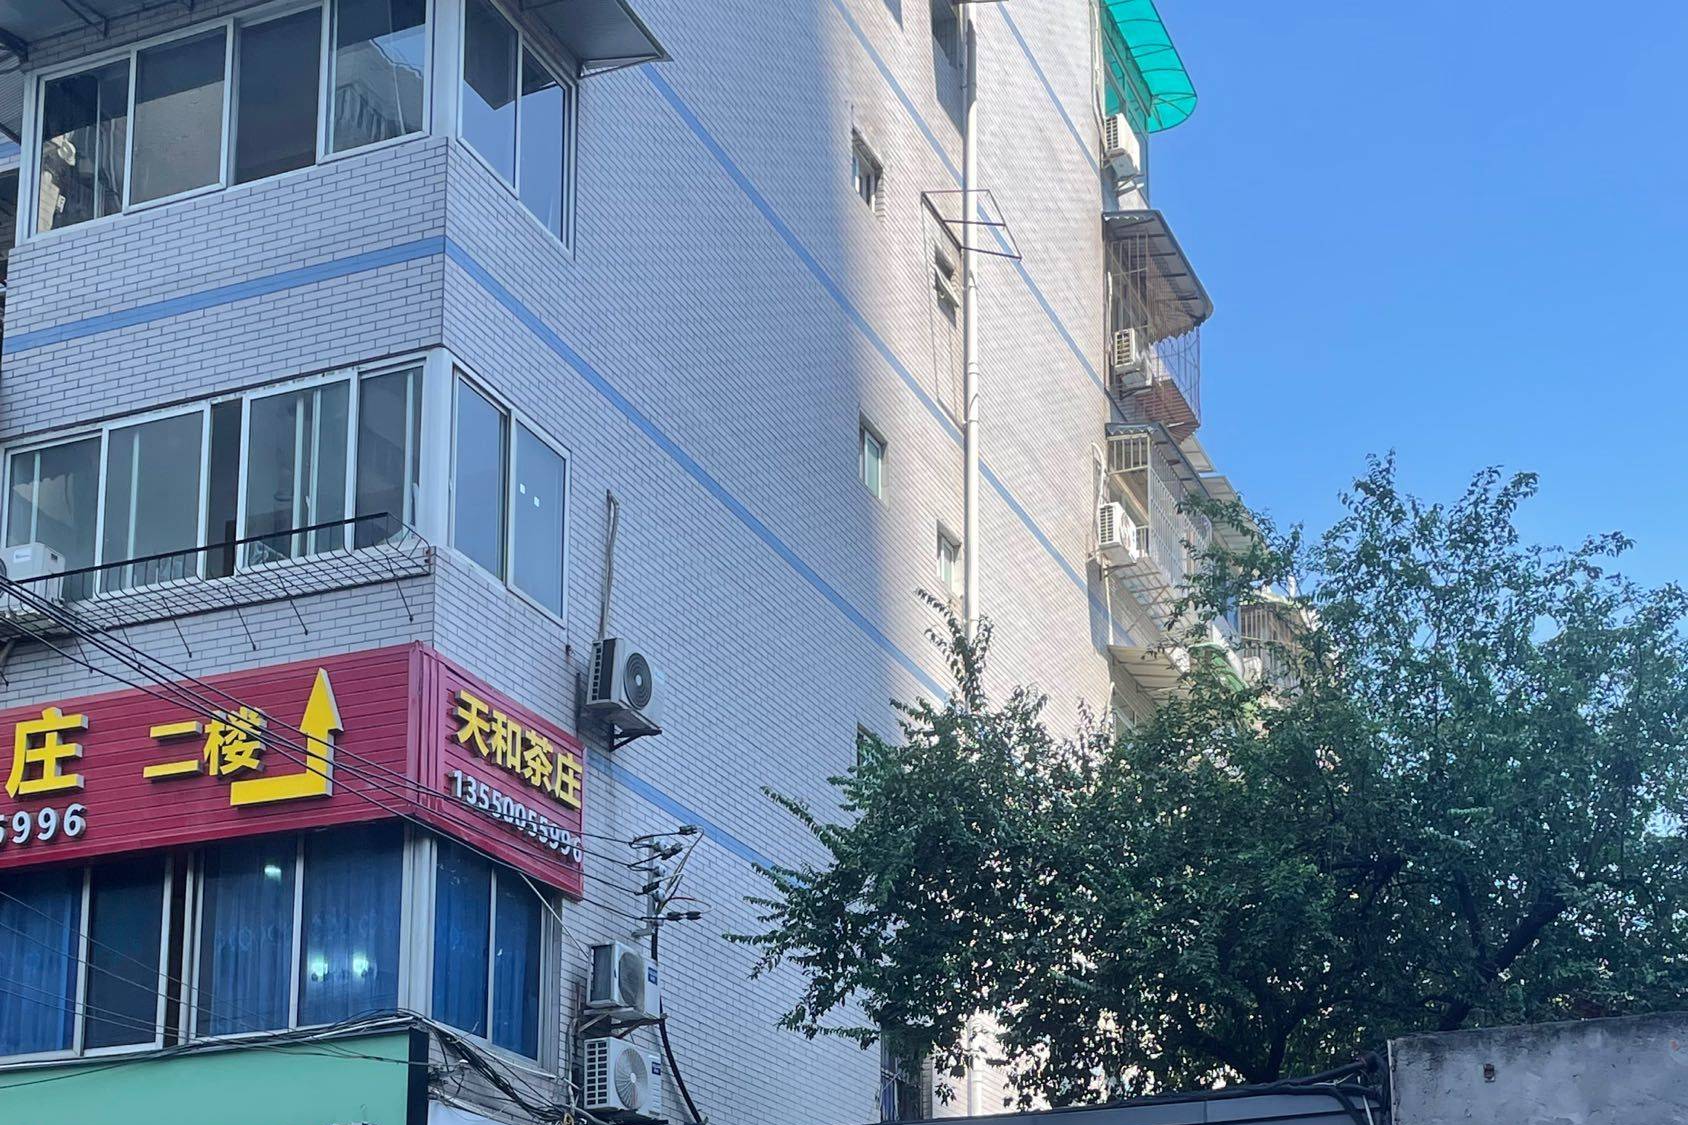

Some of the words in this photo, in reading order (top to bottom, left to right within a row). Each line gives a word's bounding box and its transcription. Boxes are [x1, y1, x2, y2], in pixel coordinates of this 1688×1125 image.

[5, 706, 88, 798] 庄
[143, 706, 268, 777] 二楼
[456, 690, 583, 809] 天和茶庄
[452, 770, 583, 863] 13550055996
